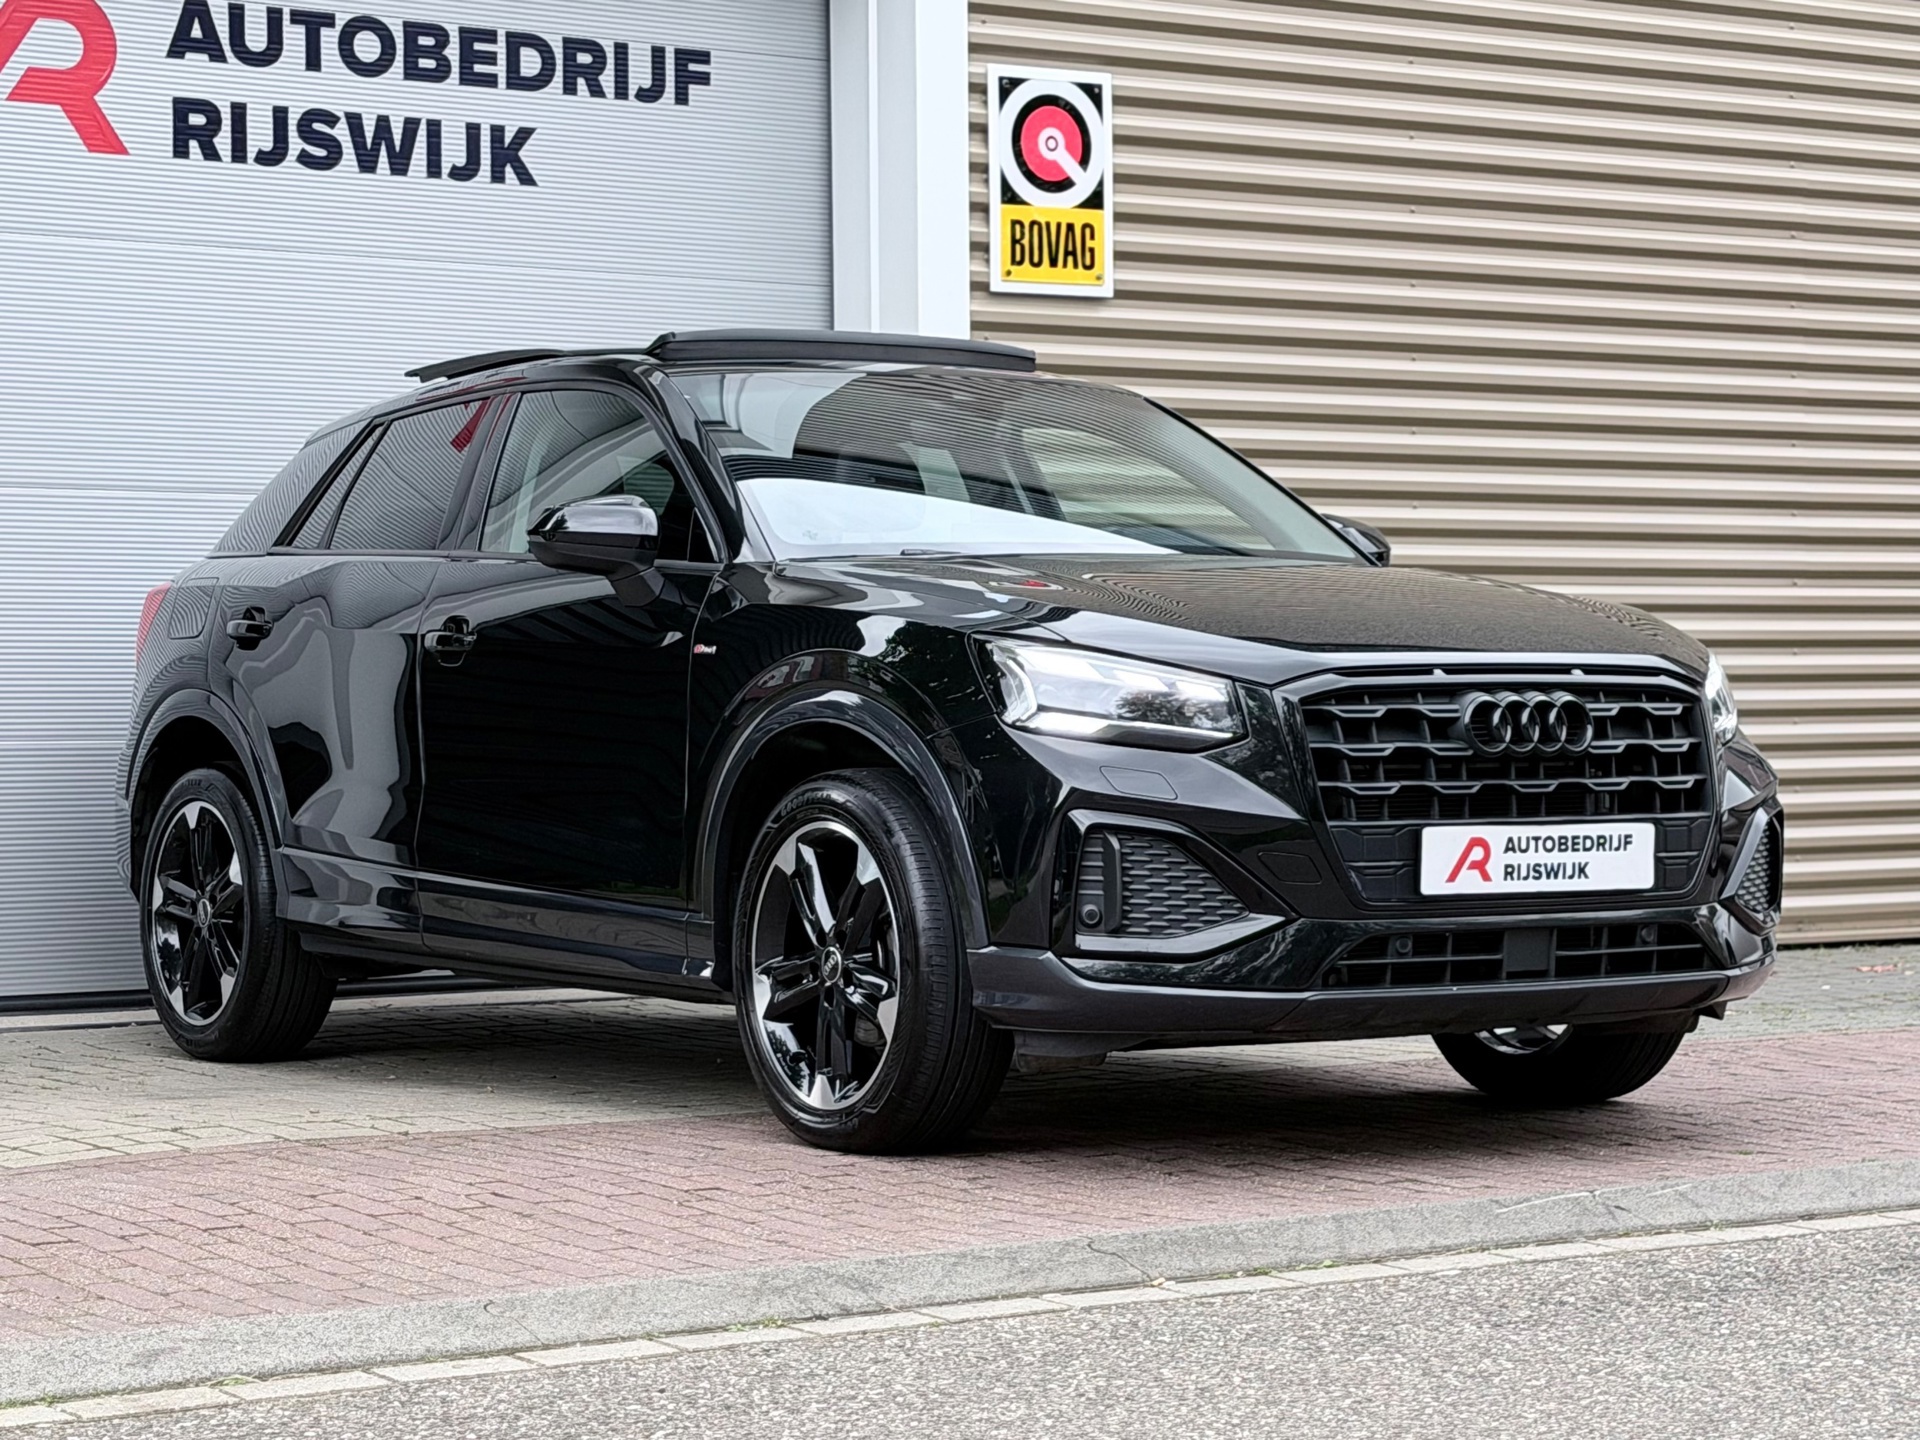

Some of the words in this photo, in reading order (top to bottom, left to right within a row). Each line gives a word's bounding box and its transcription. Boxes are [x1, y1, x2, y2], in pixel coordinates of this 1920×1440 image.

[165, 0, 712, 106] AUTOBEDRIJF
[172, 96, 539, 187] RIJSWIJK
[1010, 218, 1096, 271] BOVAG
[1503, 834, 1633, 854] AUTOBEDRIJF
[1503, 862, 1590, 881] RIJSWIJK
